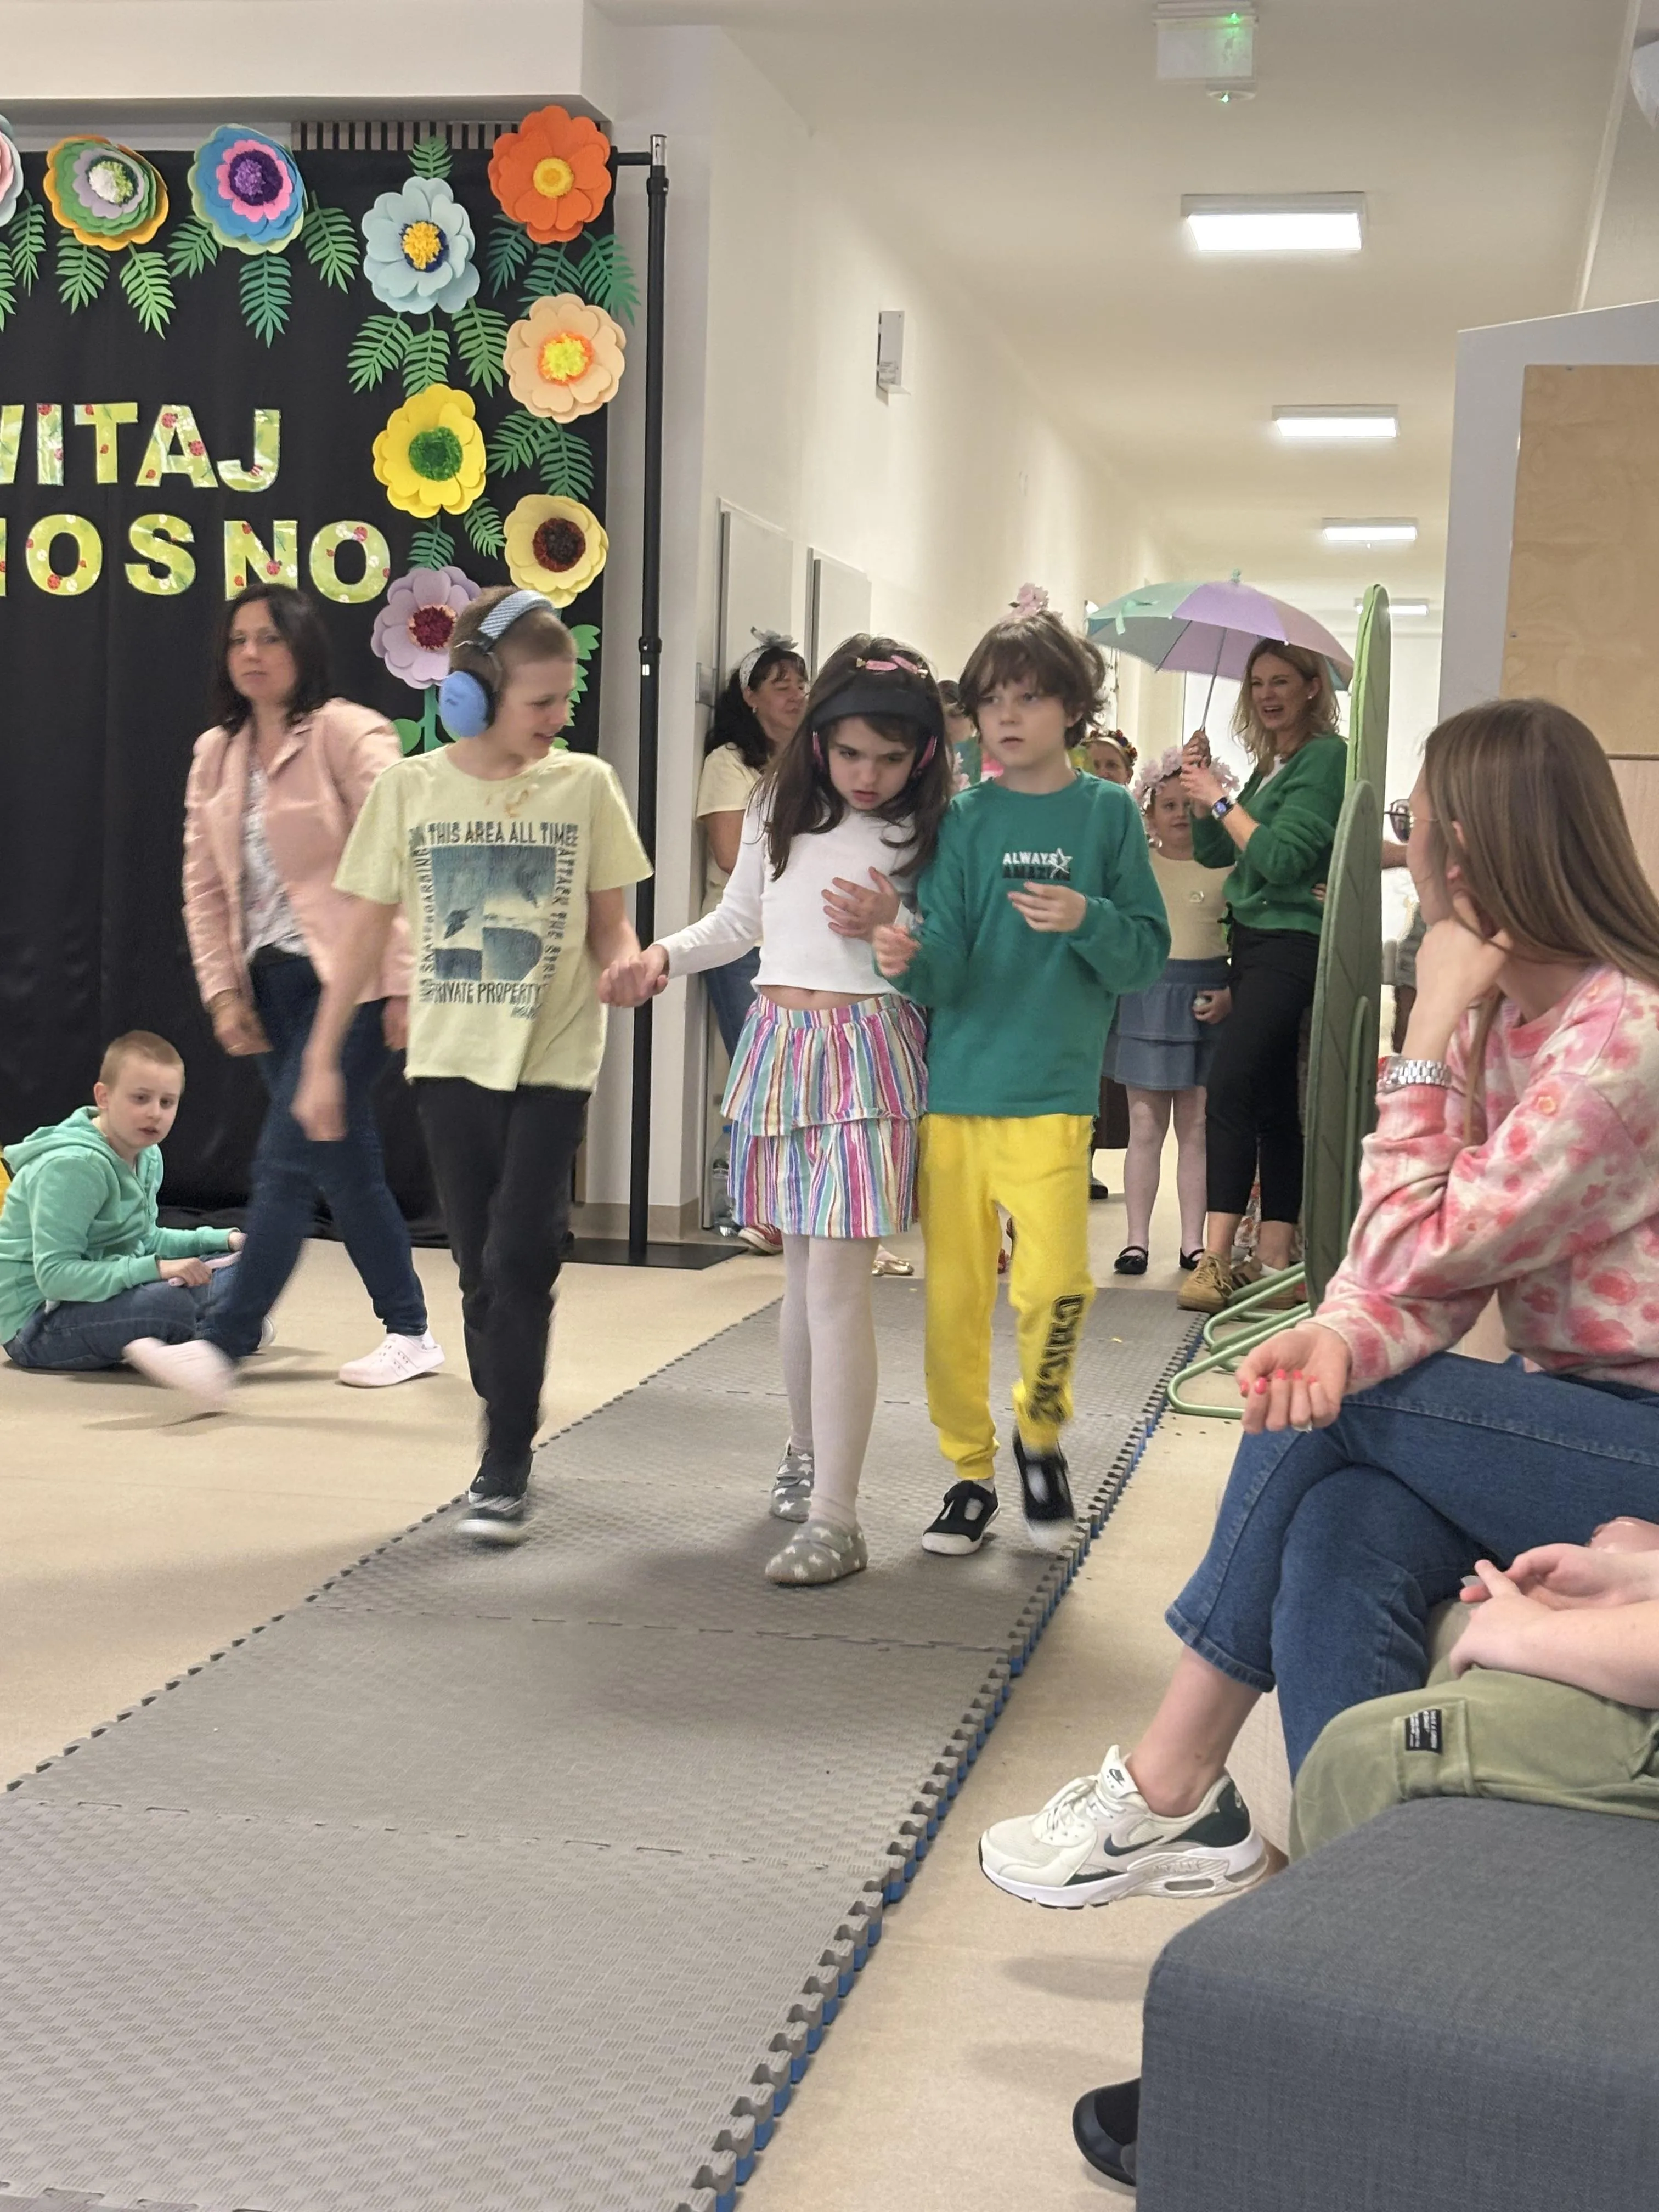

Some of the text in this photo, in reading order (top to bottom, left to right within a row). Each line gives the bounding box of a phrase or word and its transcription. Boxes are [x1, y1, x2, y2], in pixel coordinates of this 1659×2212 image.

[0, 402, 281, 492] ITAJ
[0, 514, 391, 603] OSNO
[427, 822, 461, 845] THIS
[466, 821, 505, 843] AREA
[509, 821, 537, 843] ALL
[1003, 851, 1059, 865] ALWAYS
